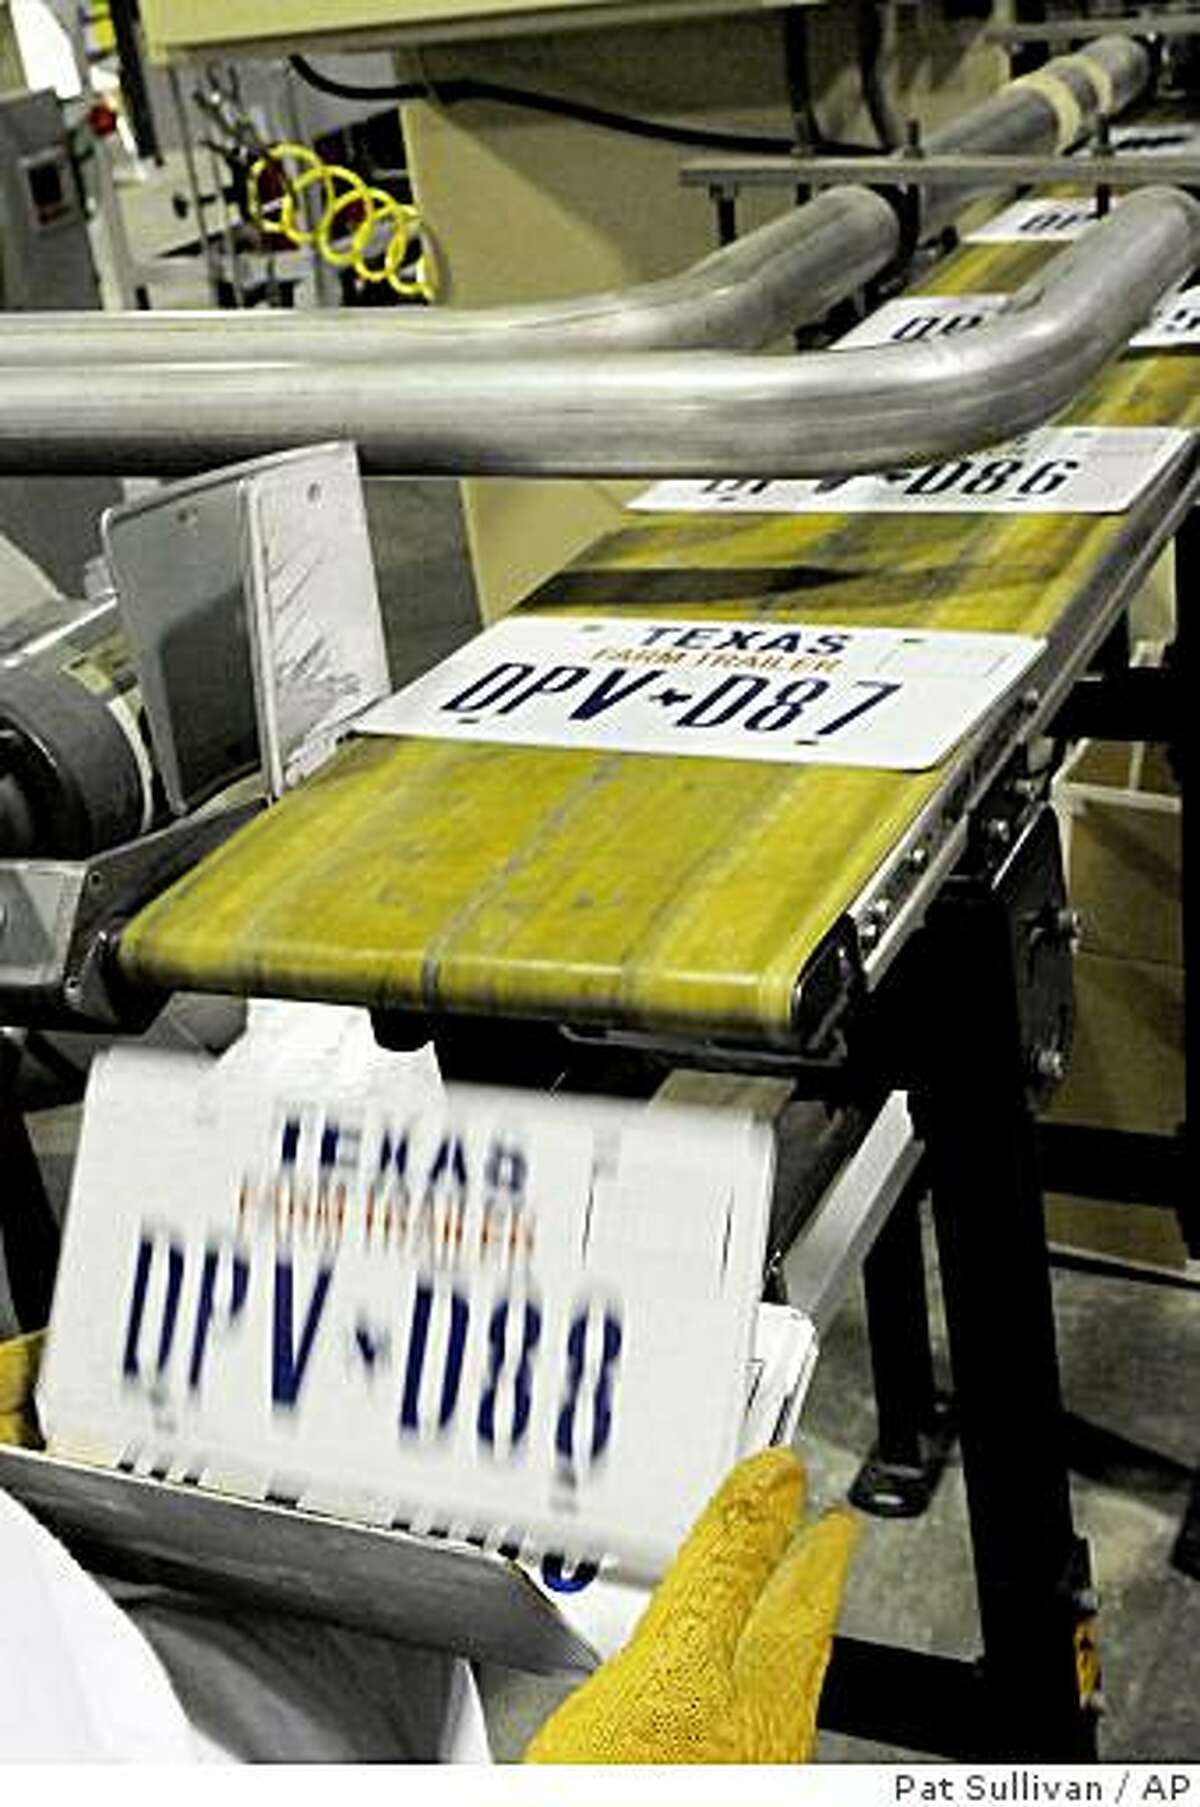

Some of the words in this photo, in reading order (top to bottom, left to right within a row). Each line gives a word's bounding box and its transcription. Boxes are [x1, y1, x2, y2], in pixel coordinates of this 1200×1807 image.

[903, 460, 1078, 495] D86
[642, 627, 854, 655] TEXAS
[591, 649, 687, 666] FARM
[696, 652, 843, 672] TRAILER
[675, 672, 903, 736] D87
